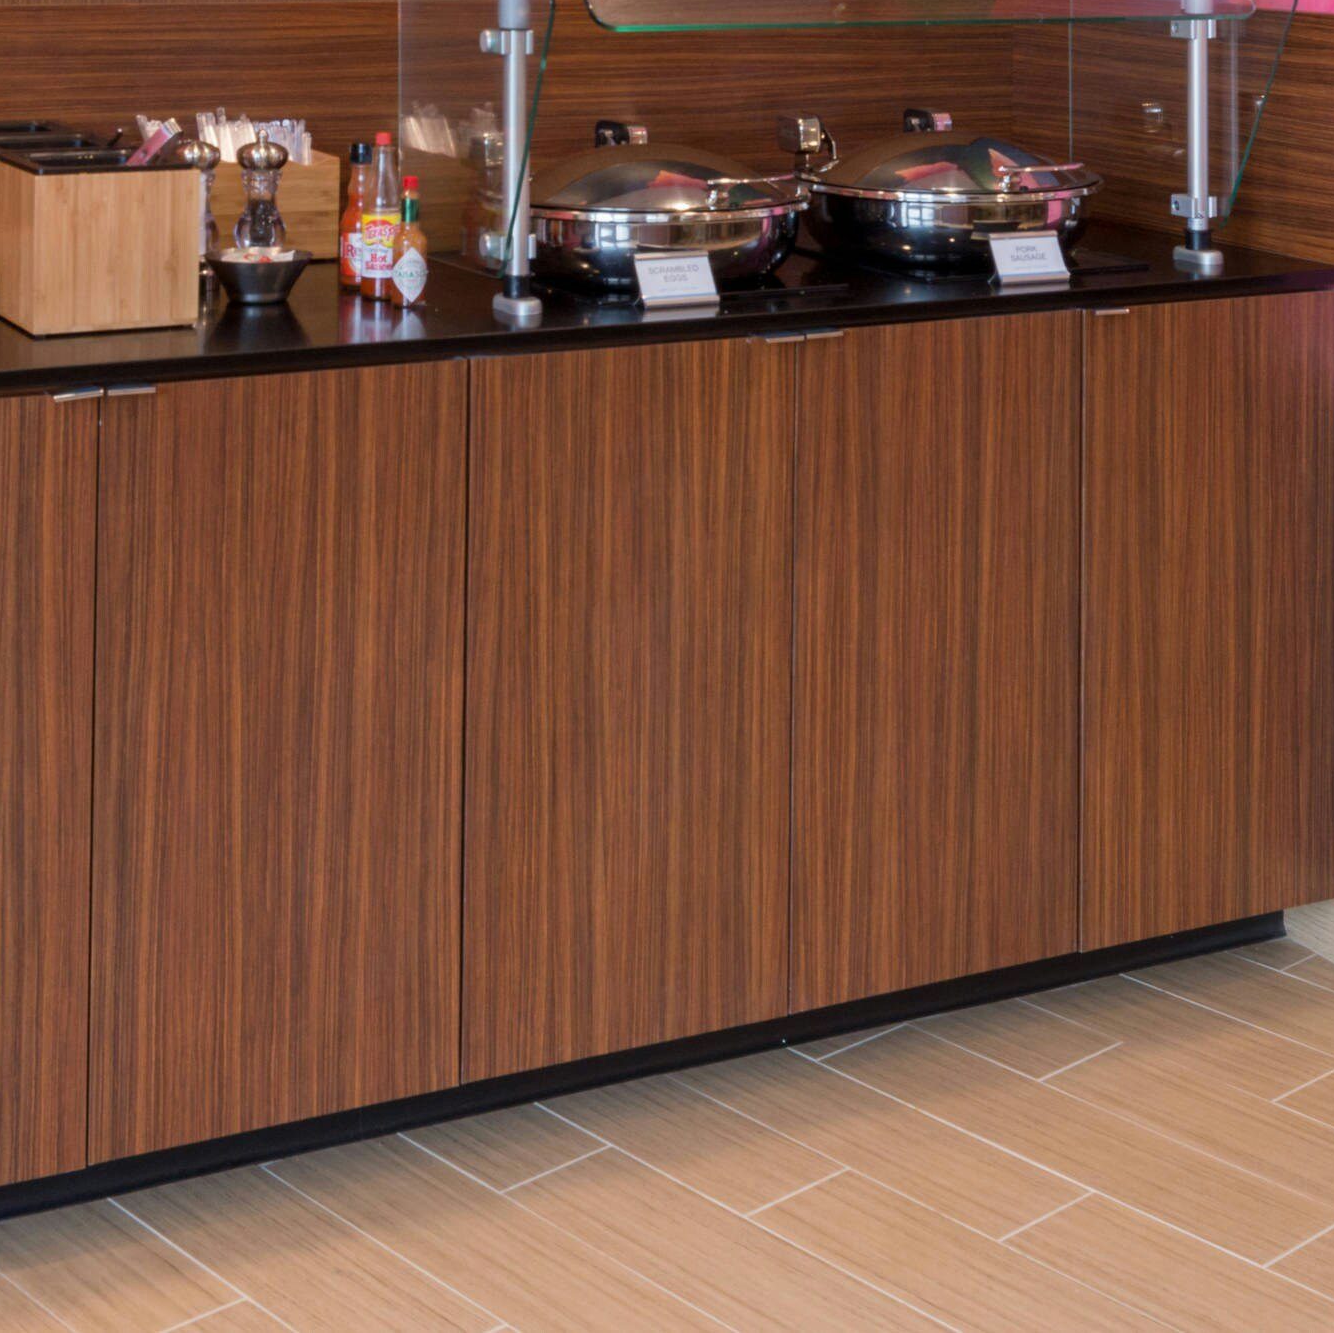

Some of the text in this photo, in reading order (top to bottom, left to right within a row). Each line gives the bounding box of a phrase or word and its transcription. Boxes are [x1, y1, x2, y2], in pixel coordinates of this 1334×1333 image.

[370, 253, 388, 263] Hot
[648, 264, 700, 275] SCRAMBLED
[663, 274, 689, 283] EGGS
